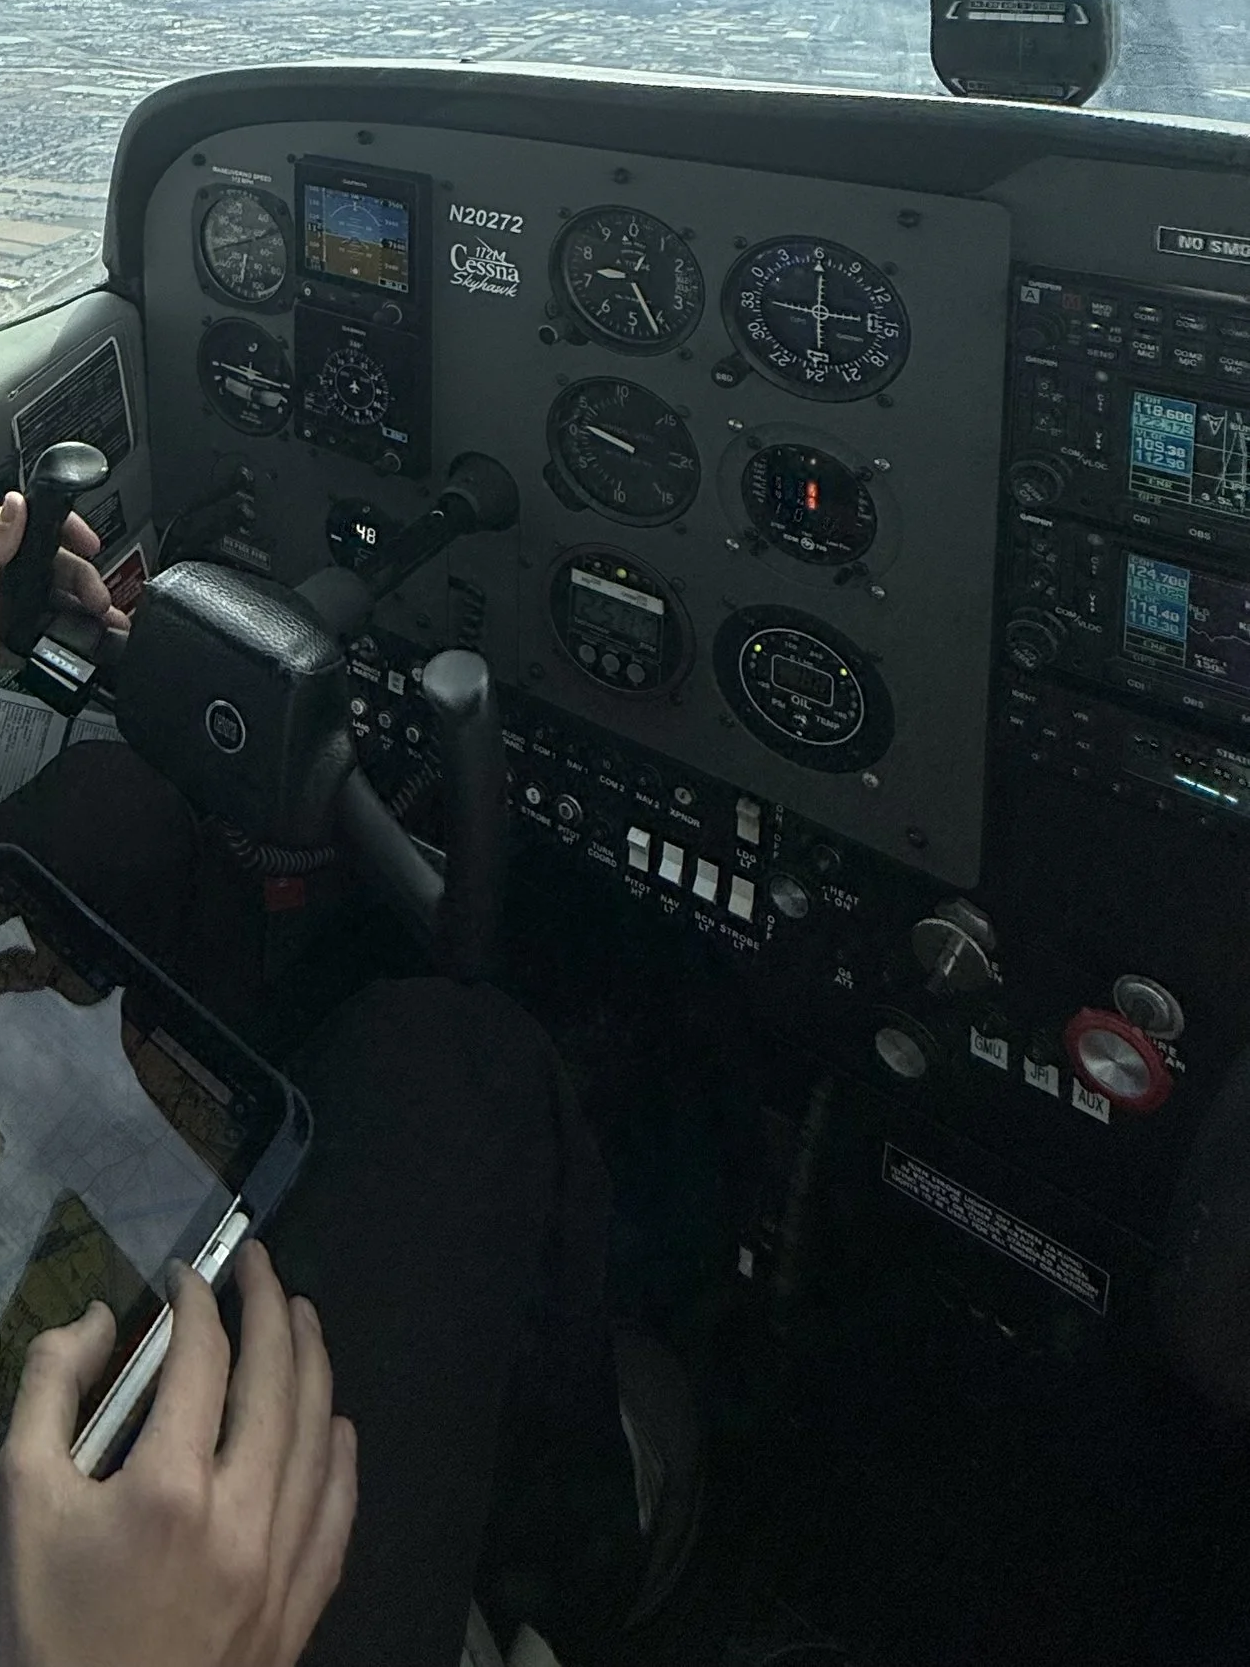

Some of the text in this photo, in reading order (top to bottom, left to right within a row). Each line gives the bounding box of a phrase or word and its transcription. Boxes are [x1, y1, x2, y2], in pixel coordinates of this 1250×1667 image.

[253, 173, 272, 183] SPEED
[449, 203, 524, 234] N20272
[601, 226, 612, 242] 9
[628, 222, 639, 238] 0
[1178, 235, 1204, 251] NO
[582, 245, 594, 261] 8
[777, 248, 790, 262] 3
[813, 246, 825, 260] 6
[450, 243, 521, 283] Cessna
[674, 258, 685, 273] 2
[849, 261, 862, 275] 9
[583, 272, 593, 288] 7
[751, 266, 764, 279] 0
[450, 272, 518, 297] Skyhawk
[673, 294, 684, 311] 3
[740, 291, 756, 310] 33
[873, 285, 892, 304] 12
[600, 298, 611, 314] 6
[627, 311, 639, 326] 5
[655, 310, 666, 325] 4
[1133, 312, 1160, 323] COM1
[747, 321, 766, 341] 30
[884, 321, 900, 339] 15
[1132, 340, 1160, 352] COM1
[768, 351, 791, 368] 27
[870, 350, 890, 368] 18
[1137, 349, 1156, 360] MIC
[1174, 348, 1204, 361] COM2
[1178, 357, 1198, 367] MIC
[805, 367, 825, 383] 24
[843, 367, 862, 383] 21
[1224, 364, 1244, 375] MIC
[617, 384, 630, 398] 10
[579, 395, 588, 409] 5
[664, 413, 678, 427] 15
[569, 423, 579, 435] 0
[577, 456, 588, 470] 5
[613, 489, 627, 504] 10
[661, 491, 675, 506] 15
[1133, 514, 1151, 525] CDI
[355, 523, 377, 545] 48
[1188, 527, 1211, 541] OBS
[1054, 606, 1103, 633] COM/VLOC
[791, 694, 812, 710] OIL
[1182, 695, 1205, 709] OBS
[815, 714, 840, 730] TEMP
[532, 742, 551, 757] COM
[566, 758, 583, 772] NAV
[599, 774, 618, 790] COM
[635, 791, 655, 806] NAV
[669, 806, 700, 829] XPNDR
[591, 840, 615, 858] TURN
[736, 847, 758, 864] LDG
[587, 847, 618, 868] COORD
[740, 856, 752, 870] LT
[624, 874, 652, 895] PITOT
[659, 893, 681, 910] NAV
[829, 885, 860, 907] HEAT
[663, 901, 677, 915] LT
[694, 910, 716, 928] BCN
[698, 921, 711, 933] LT
[766, 914, 776, 941] OFF
[719, 923, 761, 951] STROBE
[733, 937, 746, 952] LT
[974, 1034, 1001, 1059] GMU
[1030, 1065, 1050, 1085] JPI
[1078, 1092, 1105, 1115] AUX
